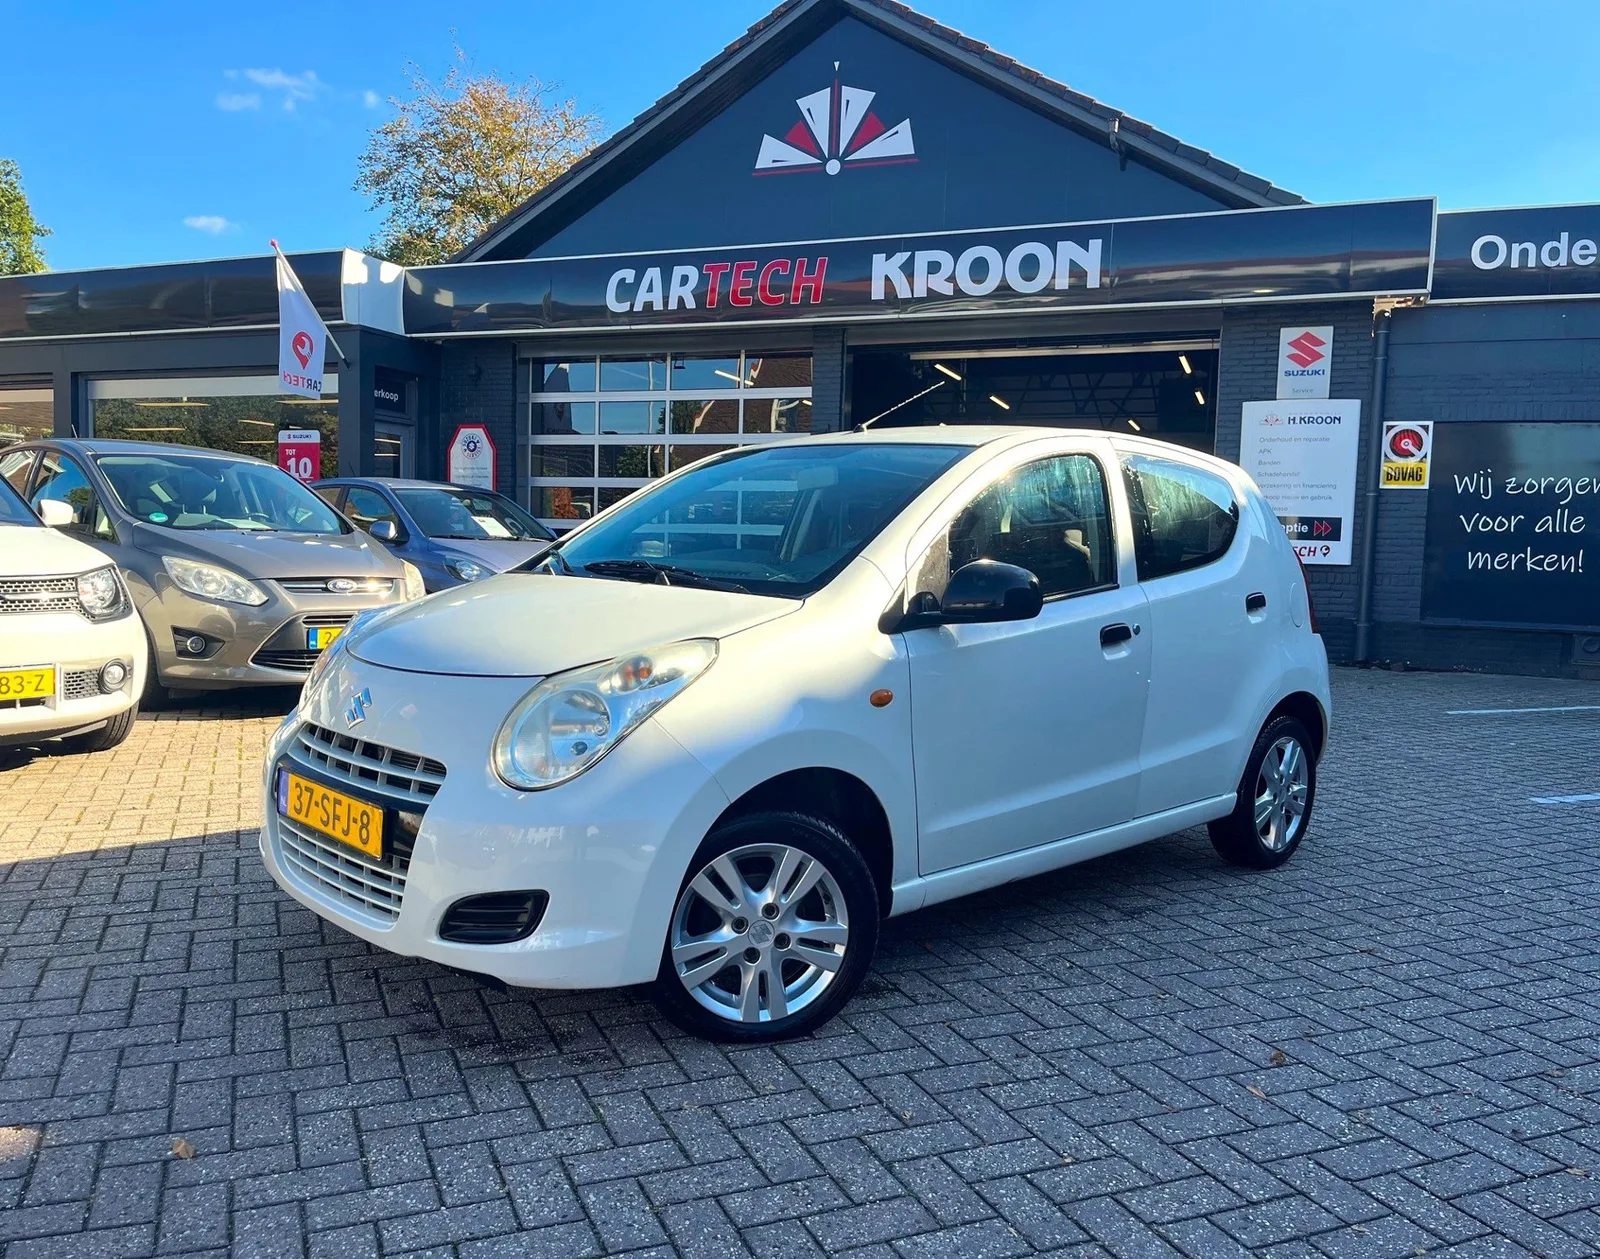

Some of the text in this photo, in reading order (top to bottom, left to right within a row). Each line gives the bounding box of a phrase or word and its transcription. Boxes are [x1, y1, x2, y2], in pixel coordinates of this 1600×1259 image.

[1470, 232, 1598, 270] Onde
[605, 239, 1103, 313] CARTECH KROON
[1283, 368, 1326, 377] SUZUKI
[373, 388, 399, 402] erkoop
[287, 457, 312, 479] 10
[1386, 466, 1423, 482] BOVAG
[1453, 468, 1492, 499] Wij
[1459, 508, 1586, 534] voor alle
[1468, 546, 1584, 573] merken!
[0, 674, 45, 694] 83-Z
[293, 782, 371, 845] 37-SFJ-8
